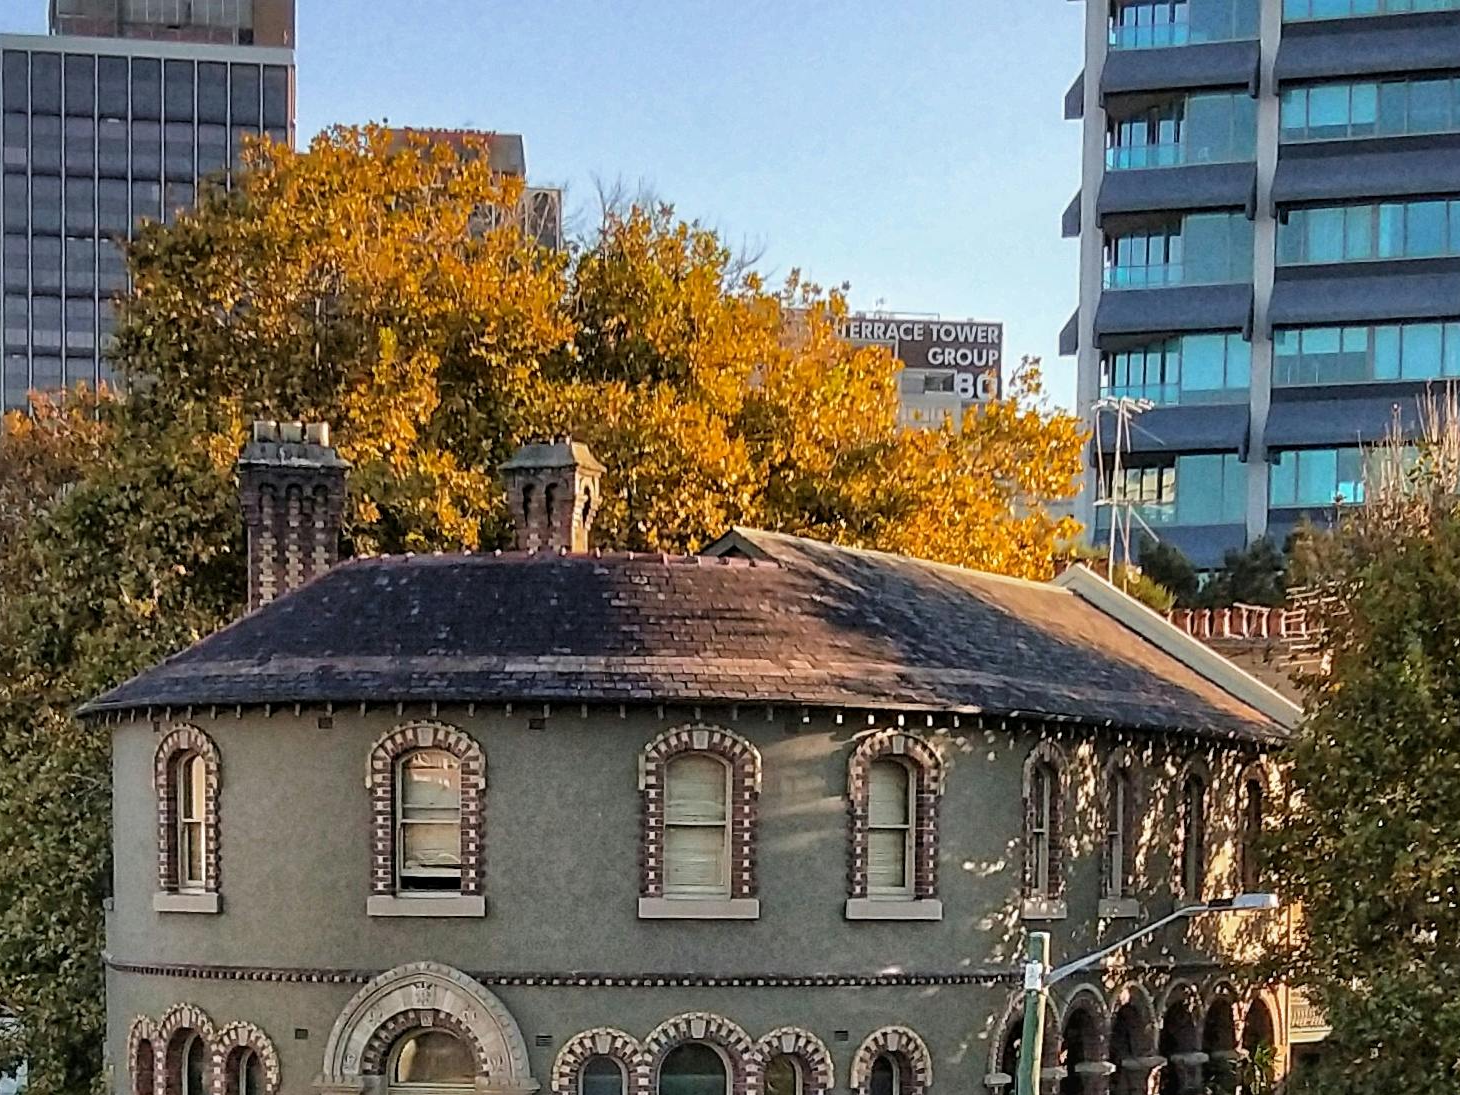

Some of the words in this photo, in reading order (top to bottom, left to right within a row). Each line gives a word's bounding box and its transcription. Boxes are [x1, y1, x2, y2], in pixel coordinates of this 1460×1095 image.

[838, 322, 924, 341] TERRACE
[929, 324, 999, 343] TOWER
[927, 347, 999, 367] GROUP
[956, 372, 998, 400] 80
